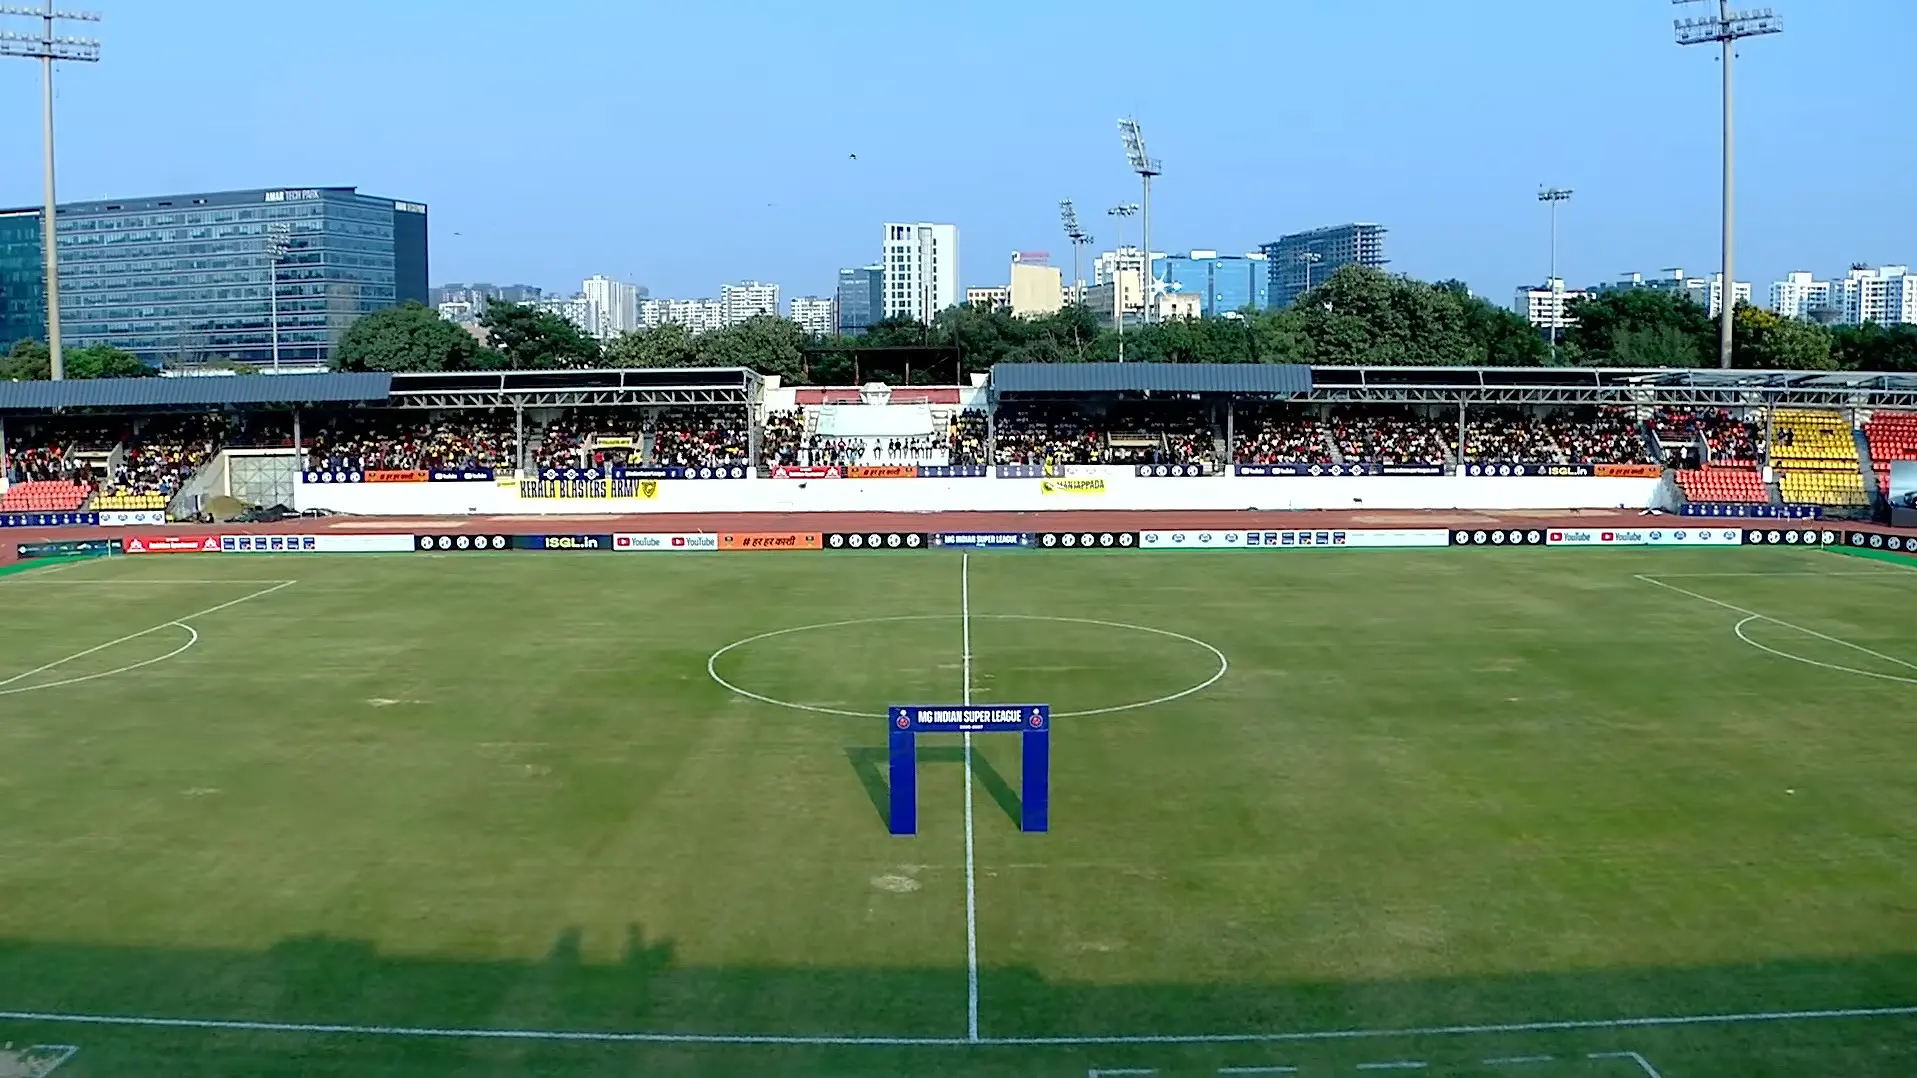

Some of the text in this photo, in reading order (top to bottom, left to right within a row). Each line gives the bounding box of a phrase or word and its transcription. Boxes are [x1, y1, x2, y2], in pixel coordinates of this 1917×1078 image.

[285, 190, 301, 201] TECH
[302, 189, 320, 200] PARK
[1548, 466, 1588, 476] ISGL.in
[520, 480, 640, 498] KERALA BLASTERS ARMY
[545, 536, 598, 548] ISGL.in
[632, 537, 660, 547] YouTube
[686, 537, 715, 547] YouTube
[1564, 532, 1591, 542] YouTube
[1615, 532, 1642, 542] YouTube
[918, 710, 1022, 723] MG INDIAN SUPER LEAGUE
